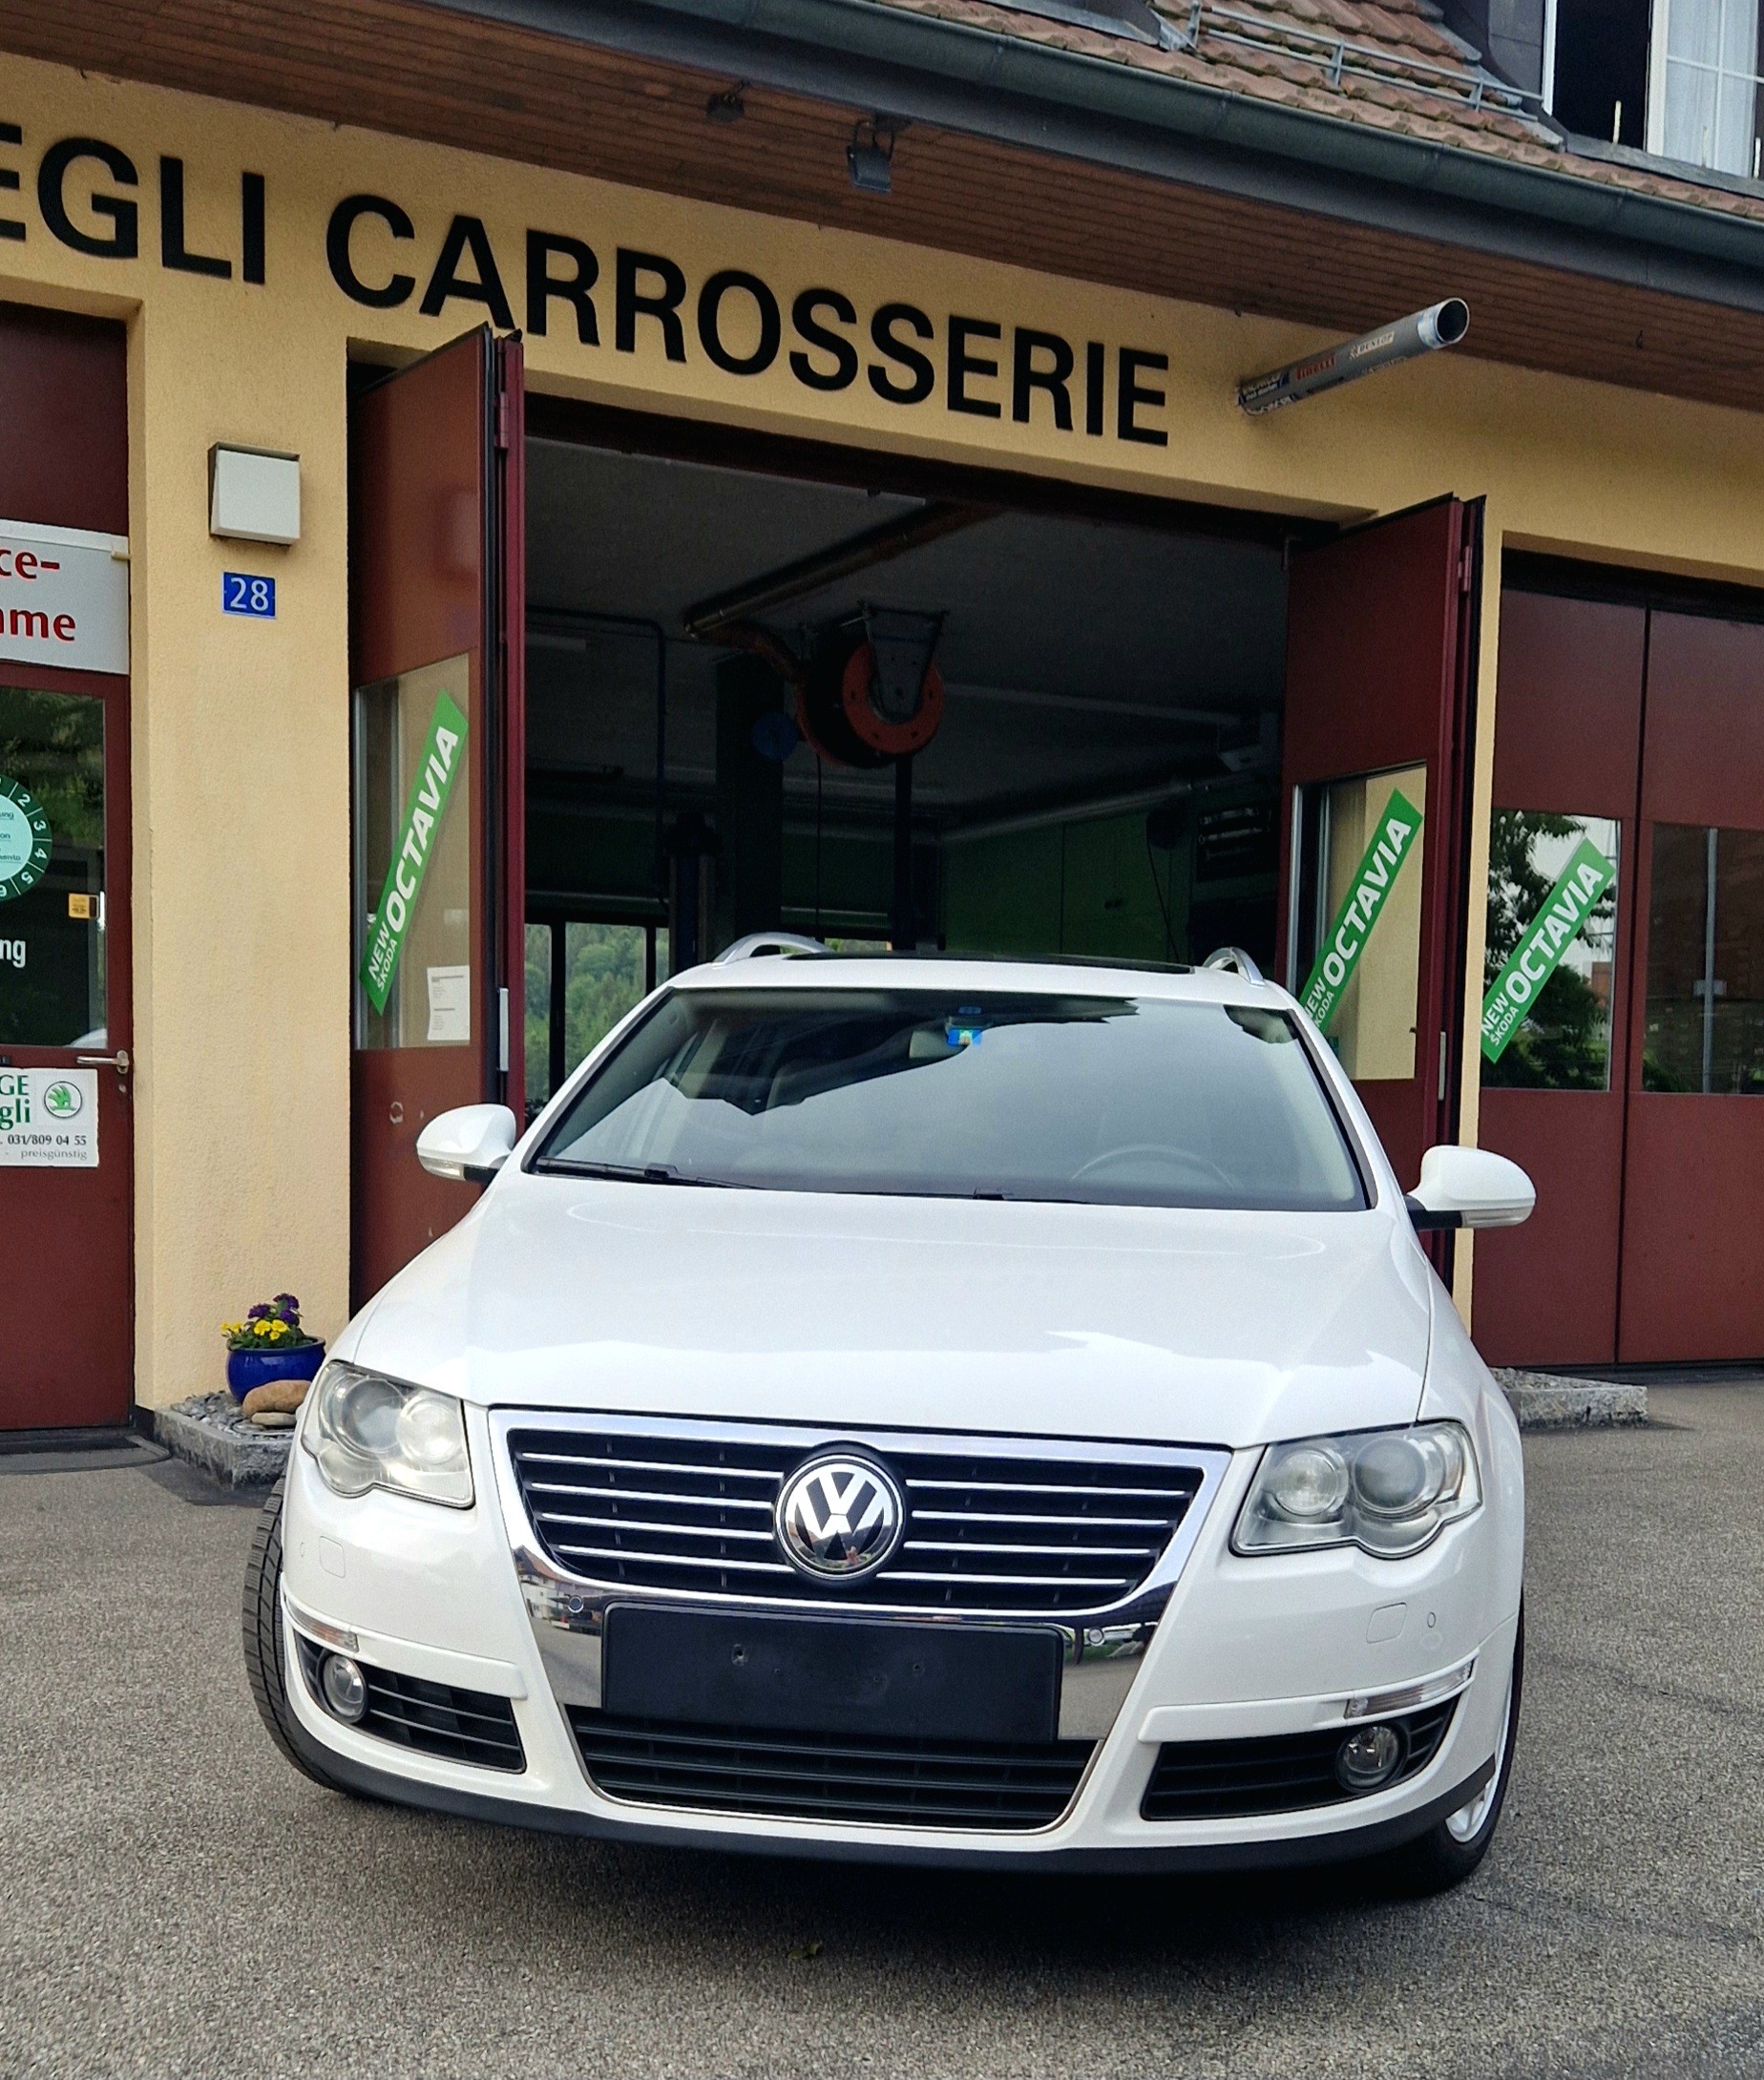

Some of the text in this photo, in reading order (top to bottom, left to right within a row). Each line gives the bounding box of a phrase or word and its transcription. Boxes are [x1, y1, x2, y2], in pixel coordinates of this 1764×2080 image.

[326, 194, 1168, 447] CARROSSERIE
[230, 577, 269, 612] 28
[0, 608, 76, 641] me
[368, 921, 389, 980] NEW
[386, 725, 459, 934] OCTAVIA
[1322, 817, 1412, 987] OCTAVIA
[1481, 863, 1604, 1037] NEW OCTAVIA
[1313, 991, 1334, 1028] KODA
[8, 1134, 87, 1145] 031/809 04 55
[20, 1148, 88, 1160] preisgünstig
